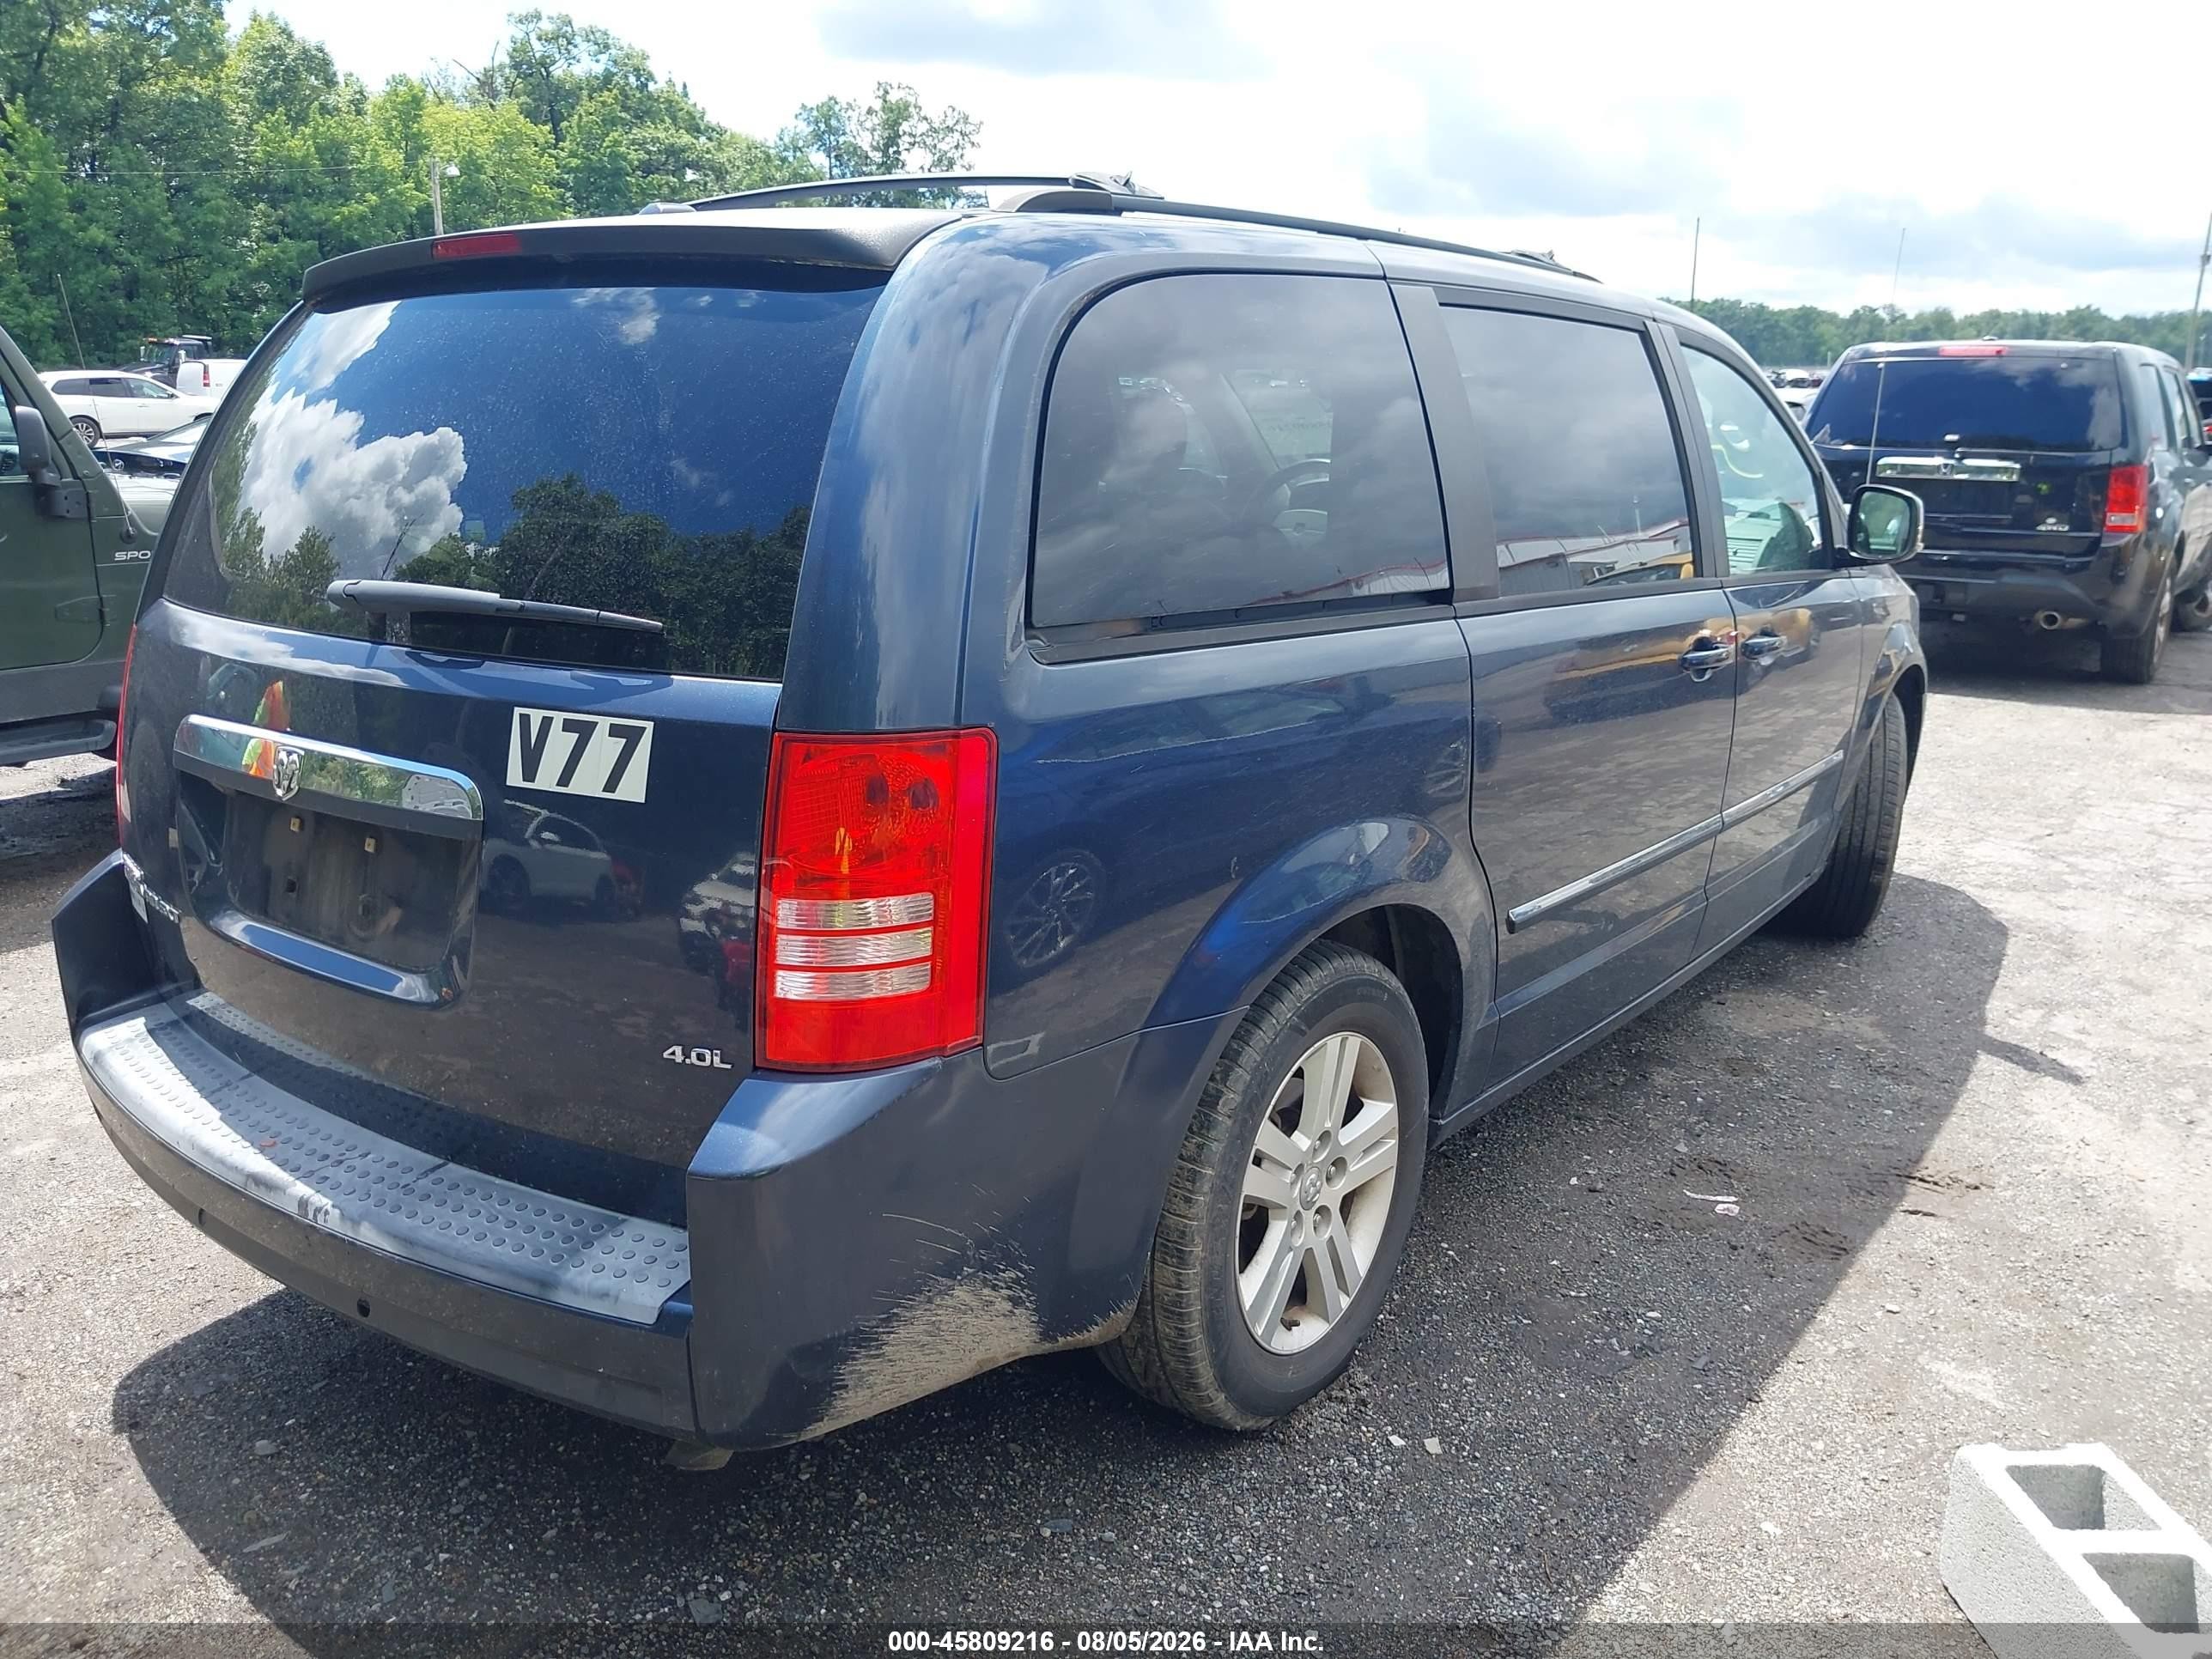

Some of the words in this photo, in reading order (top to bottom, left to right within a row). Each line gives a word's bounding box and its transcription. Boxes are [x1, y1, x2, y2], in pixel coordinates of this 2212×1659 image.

[114, 550, 151, 561] SPO
[519, 713, 647, 793] V77
[662, 1044, 733, 1069] 4.0L
